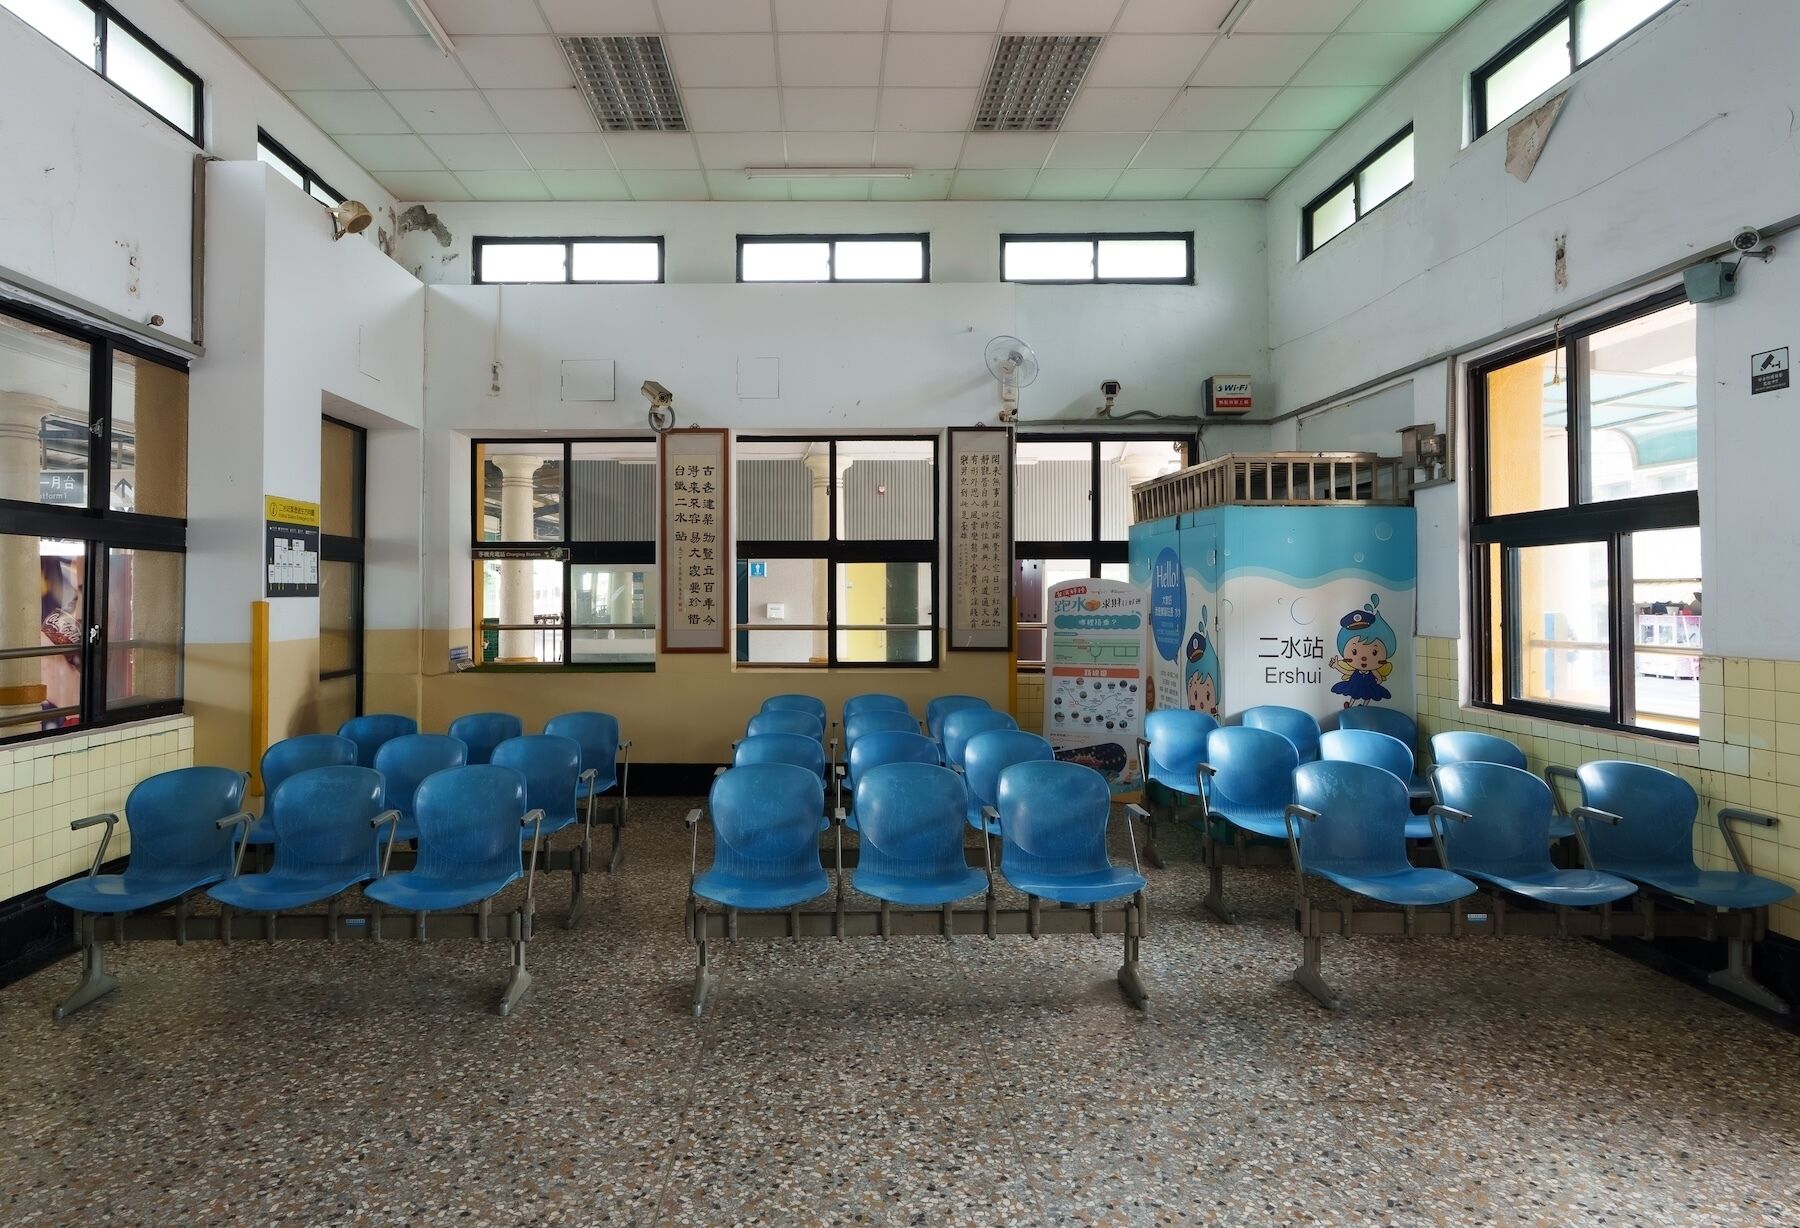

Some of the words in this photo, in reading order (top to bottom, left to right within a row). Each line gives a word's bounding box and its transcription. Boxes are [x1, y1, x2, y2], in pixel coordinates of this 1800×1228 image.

[1156, 561, 1179, 588] Hello!
[1258, 636, 1324, 659] 二水站
[1265, 667, 1322, 684] Ershui
